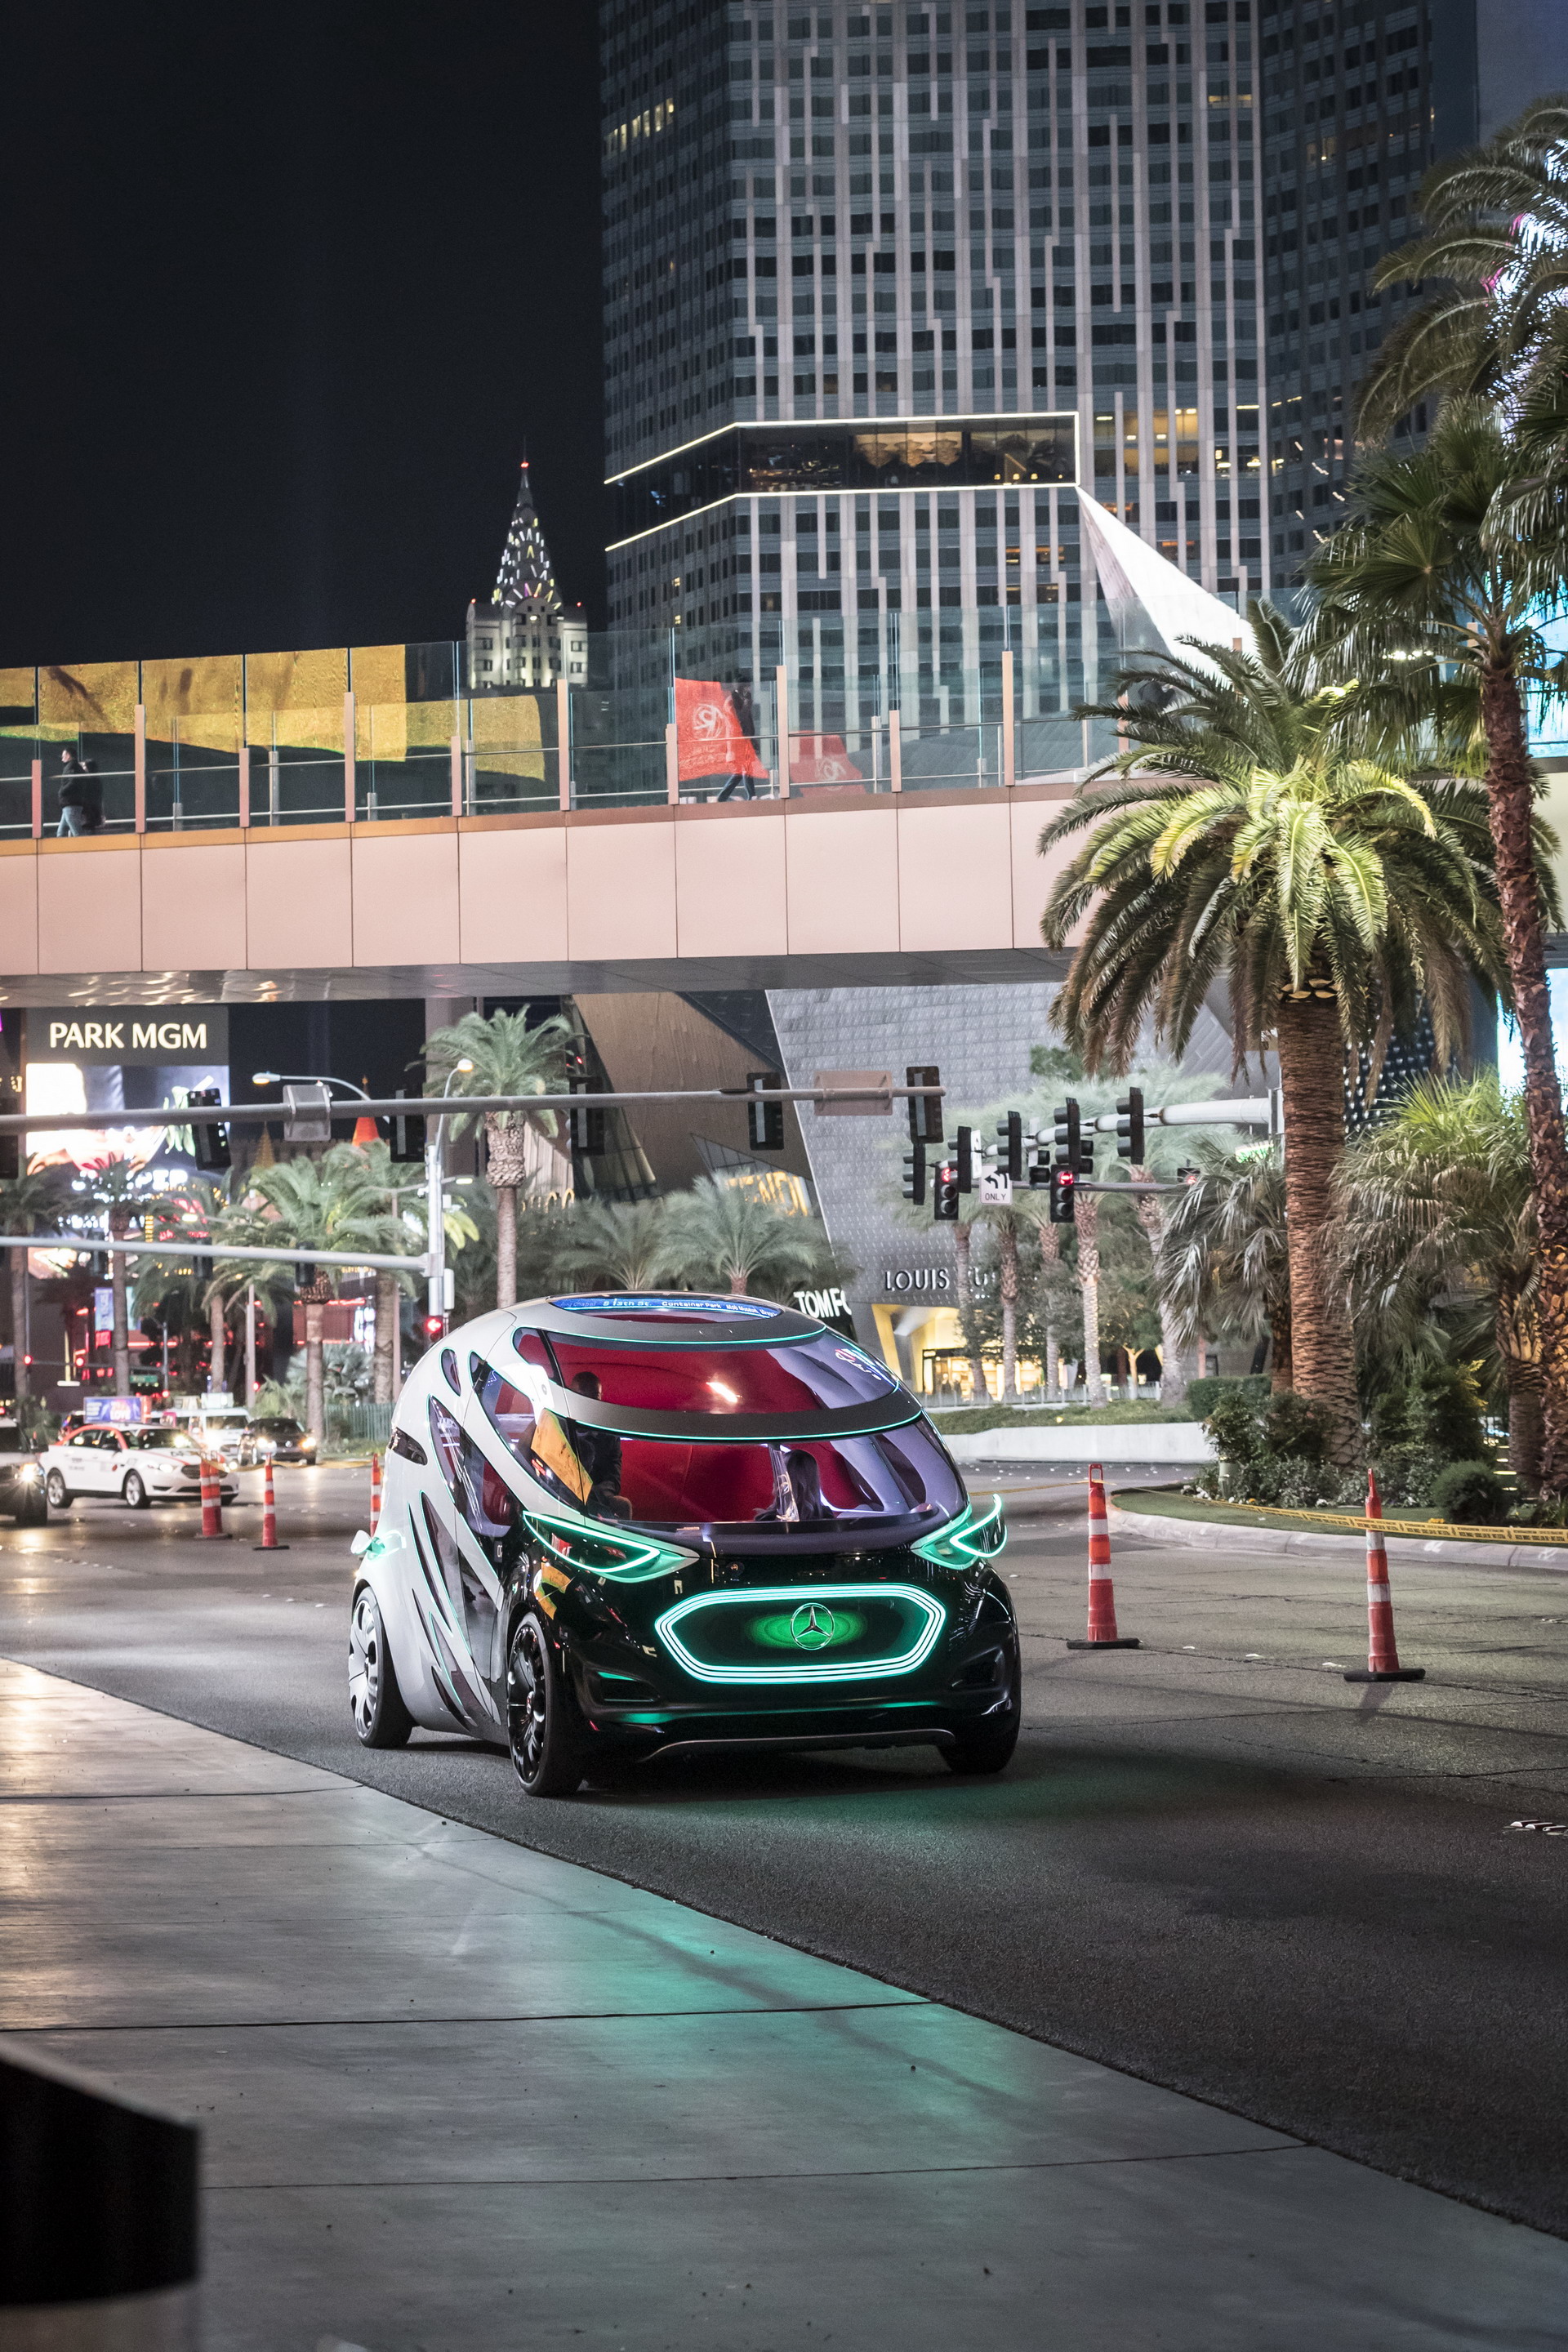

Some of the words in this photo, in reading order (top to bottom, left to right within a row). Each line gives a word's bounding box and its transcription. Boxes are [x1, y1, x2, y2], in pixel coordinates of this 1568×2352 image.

[50, 1022, 125, 1049] PARK
[132, 1022, 207, 1049] MGM
[726, 1170, 808, 1216] NDI
[884, 1267, 951, 1292] LOUIS
